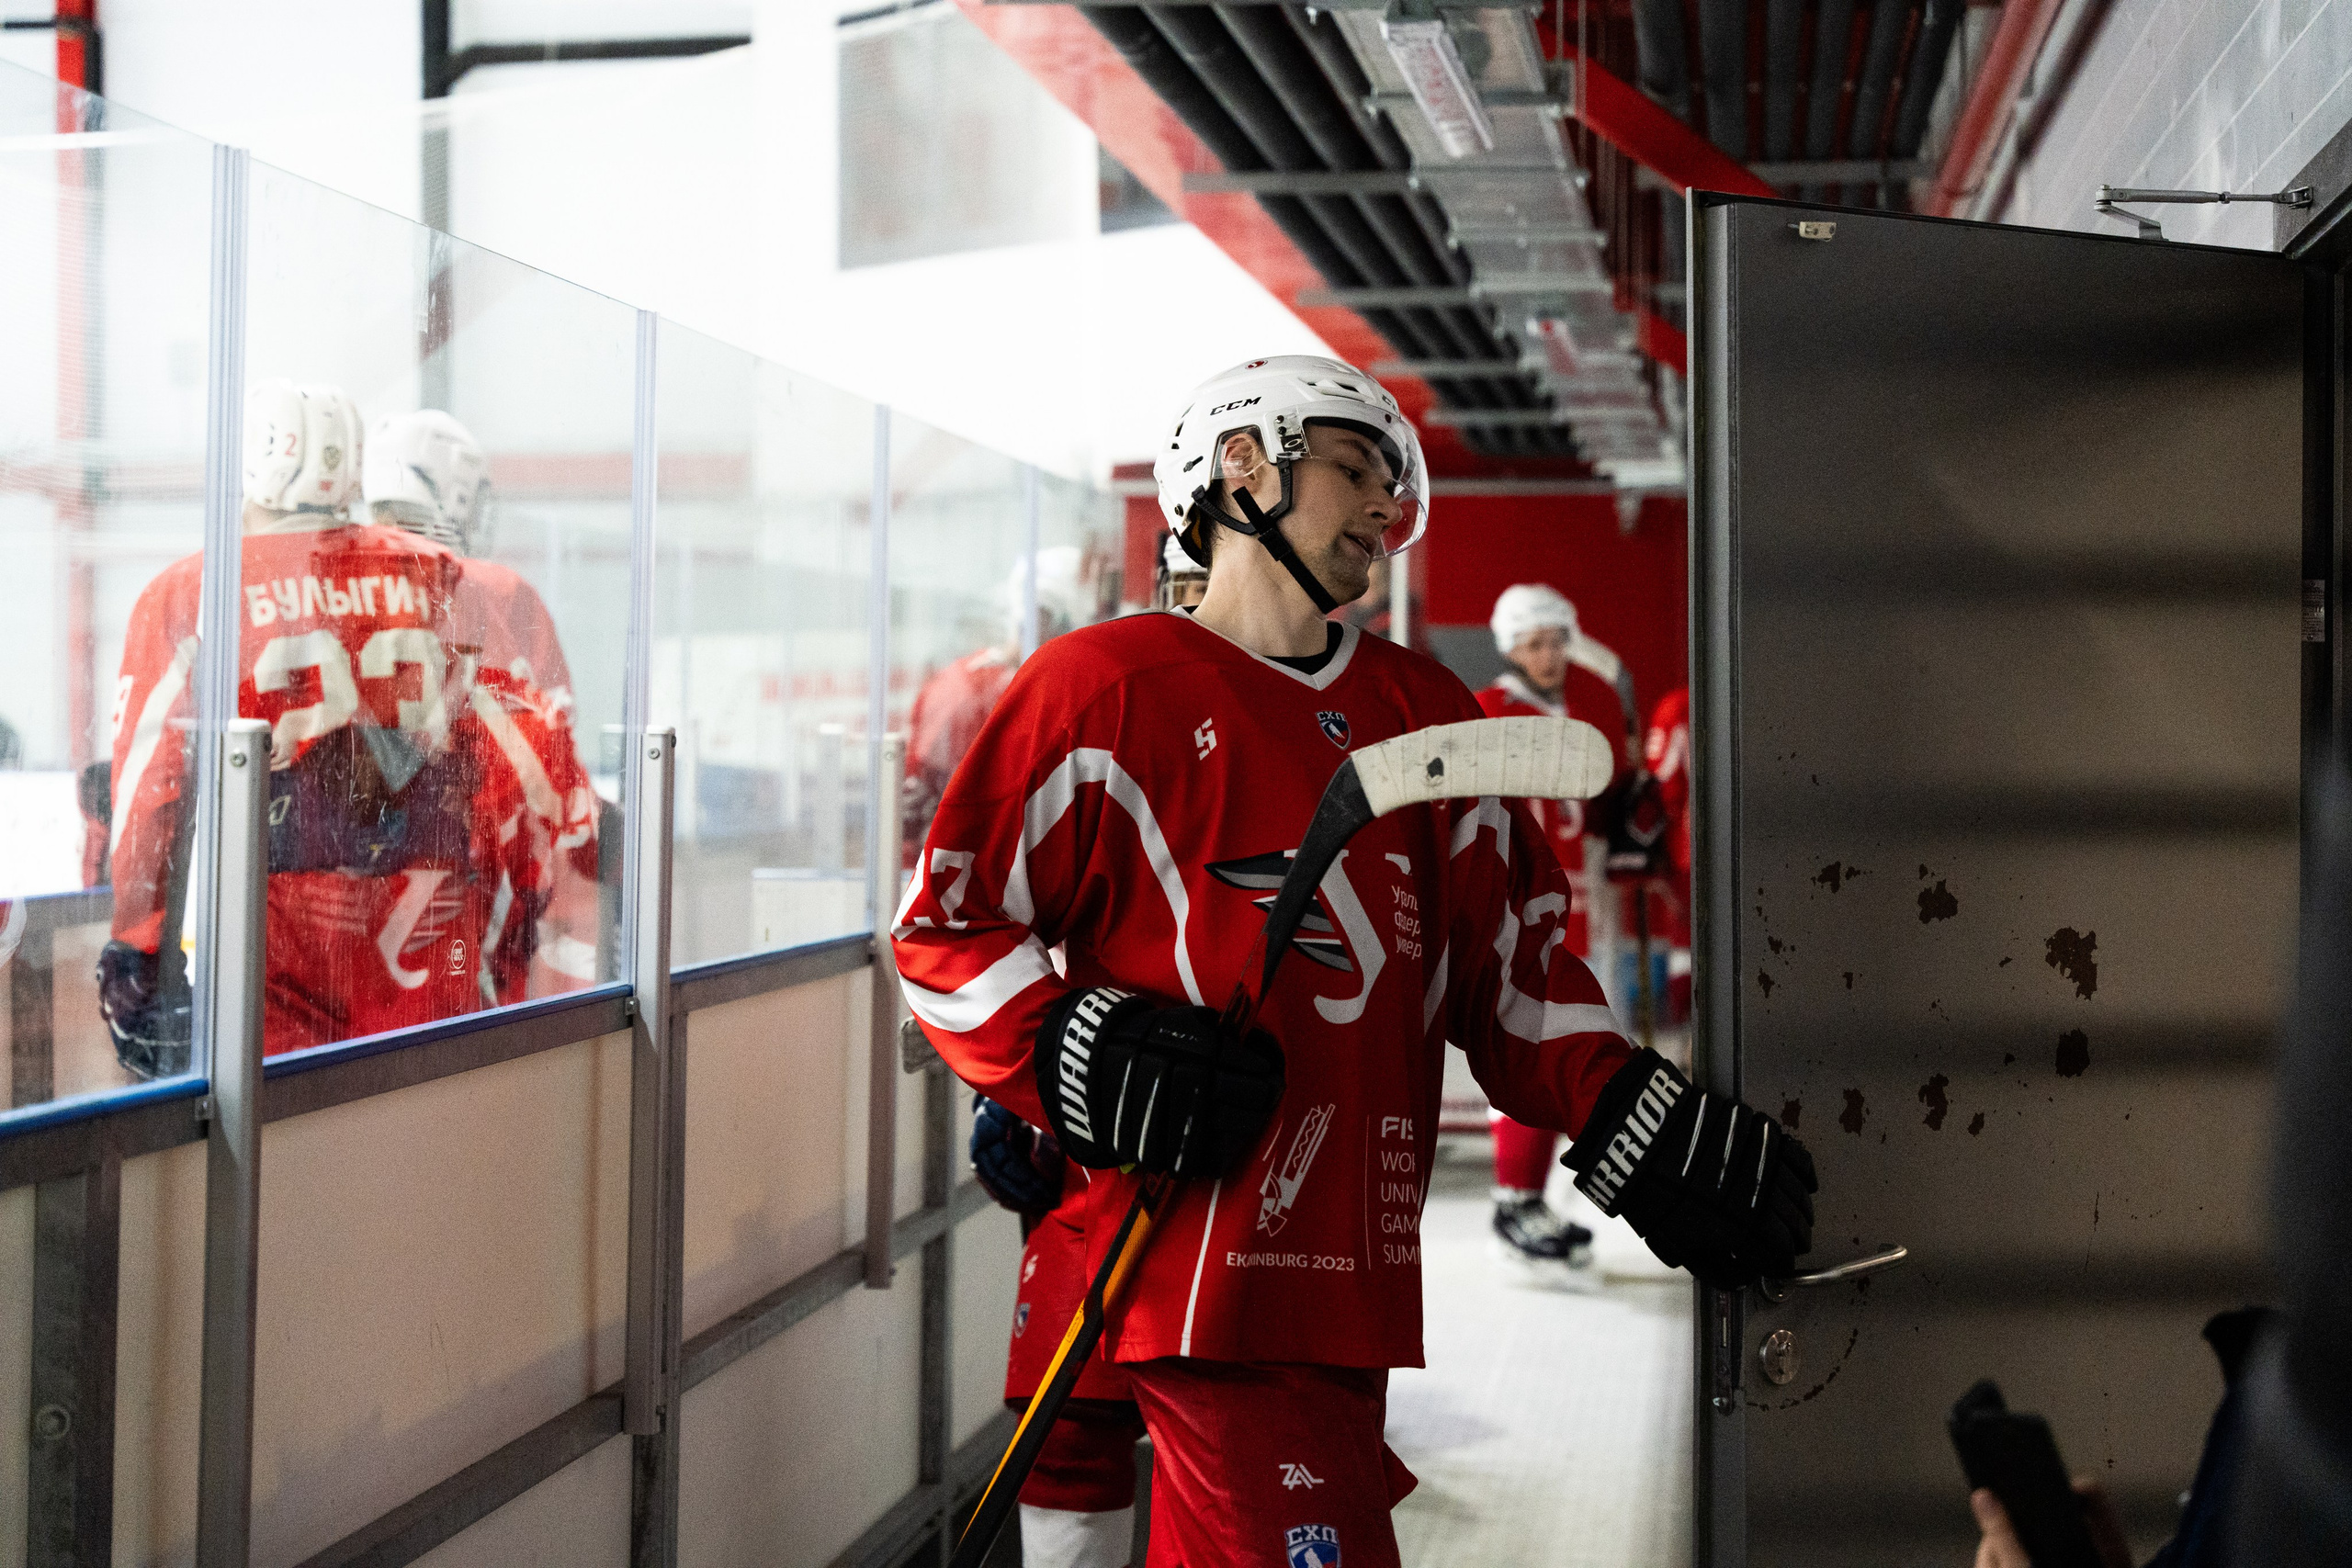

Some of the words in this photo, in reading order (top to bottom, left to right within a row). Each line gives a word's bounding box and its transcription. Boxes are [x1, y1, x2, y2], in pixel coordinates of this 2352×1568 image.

[1210, 396, 1261, 415] CCM
[1582, 1068, 1683, 1213] ARRIOR
[1312, 1256, 1355, 1271] 2023
